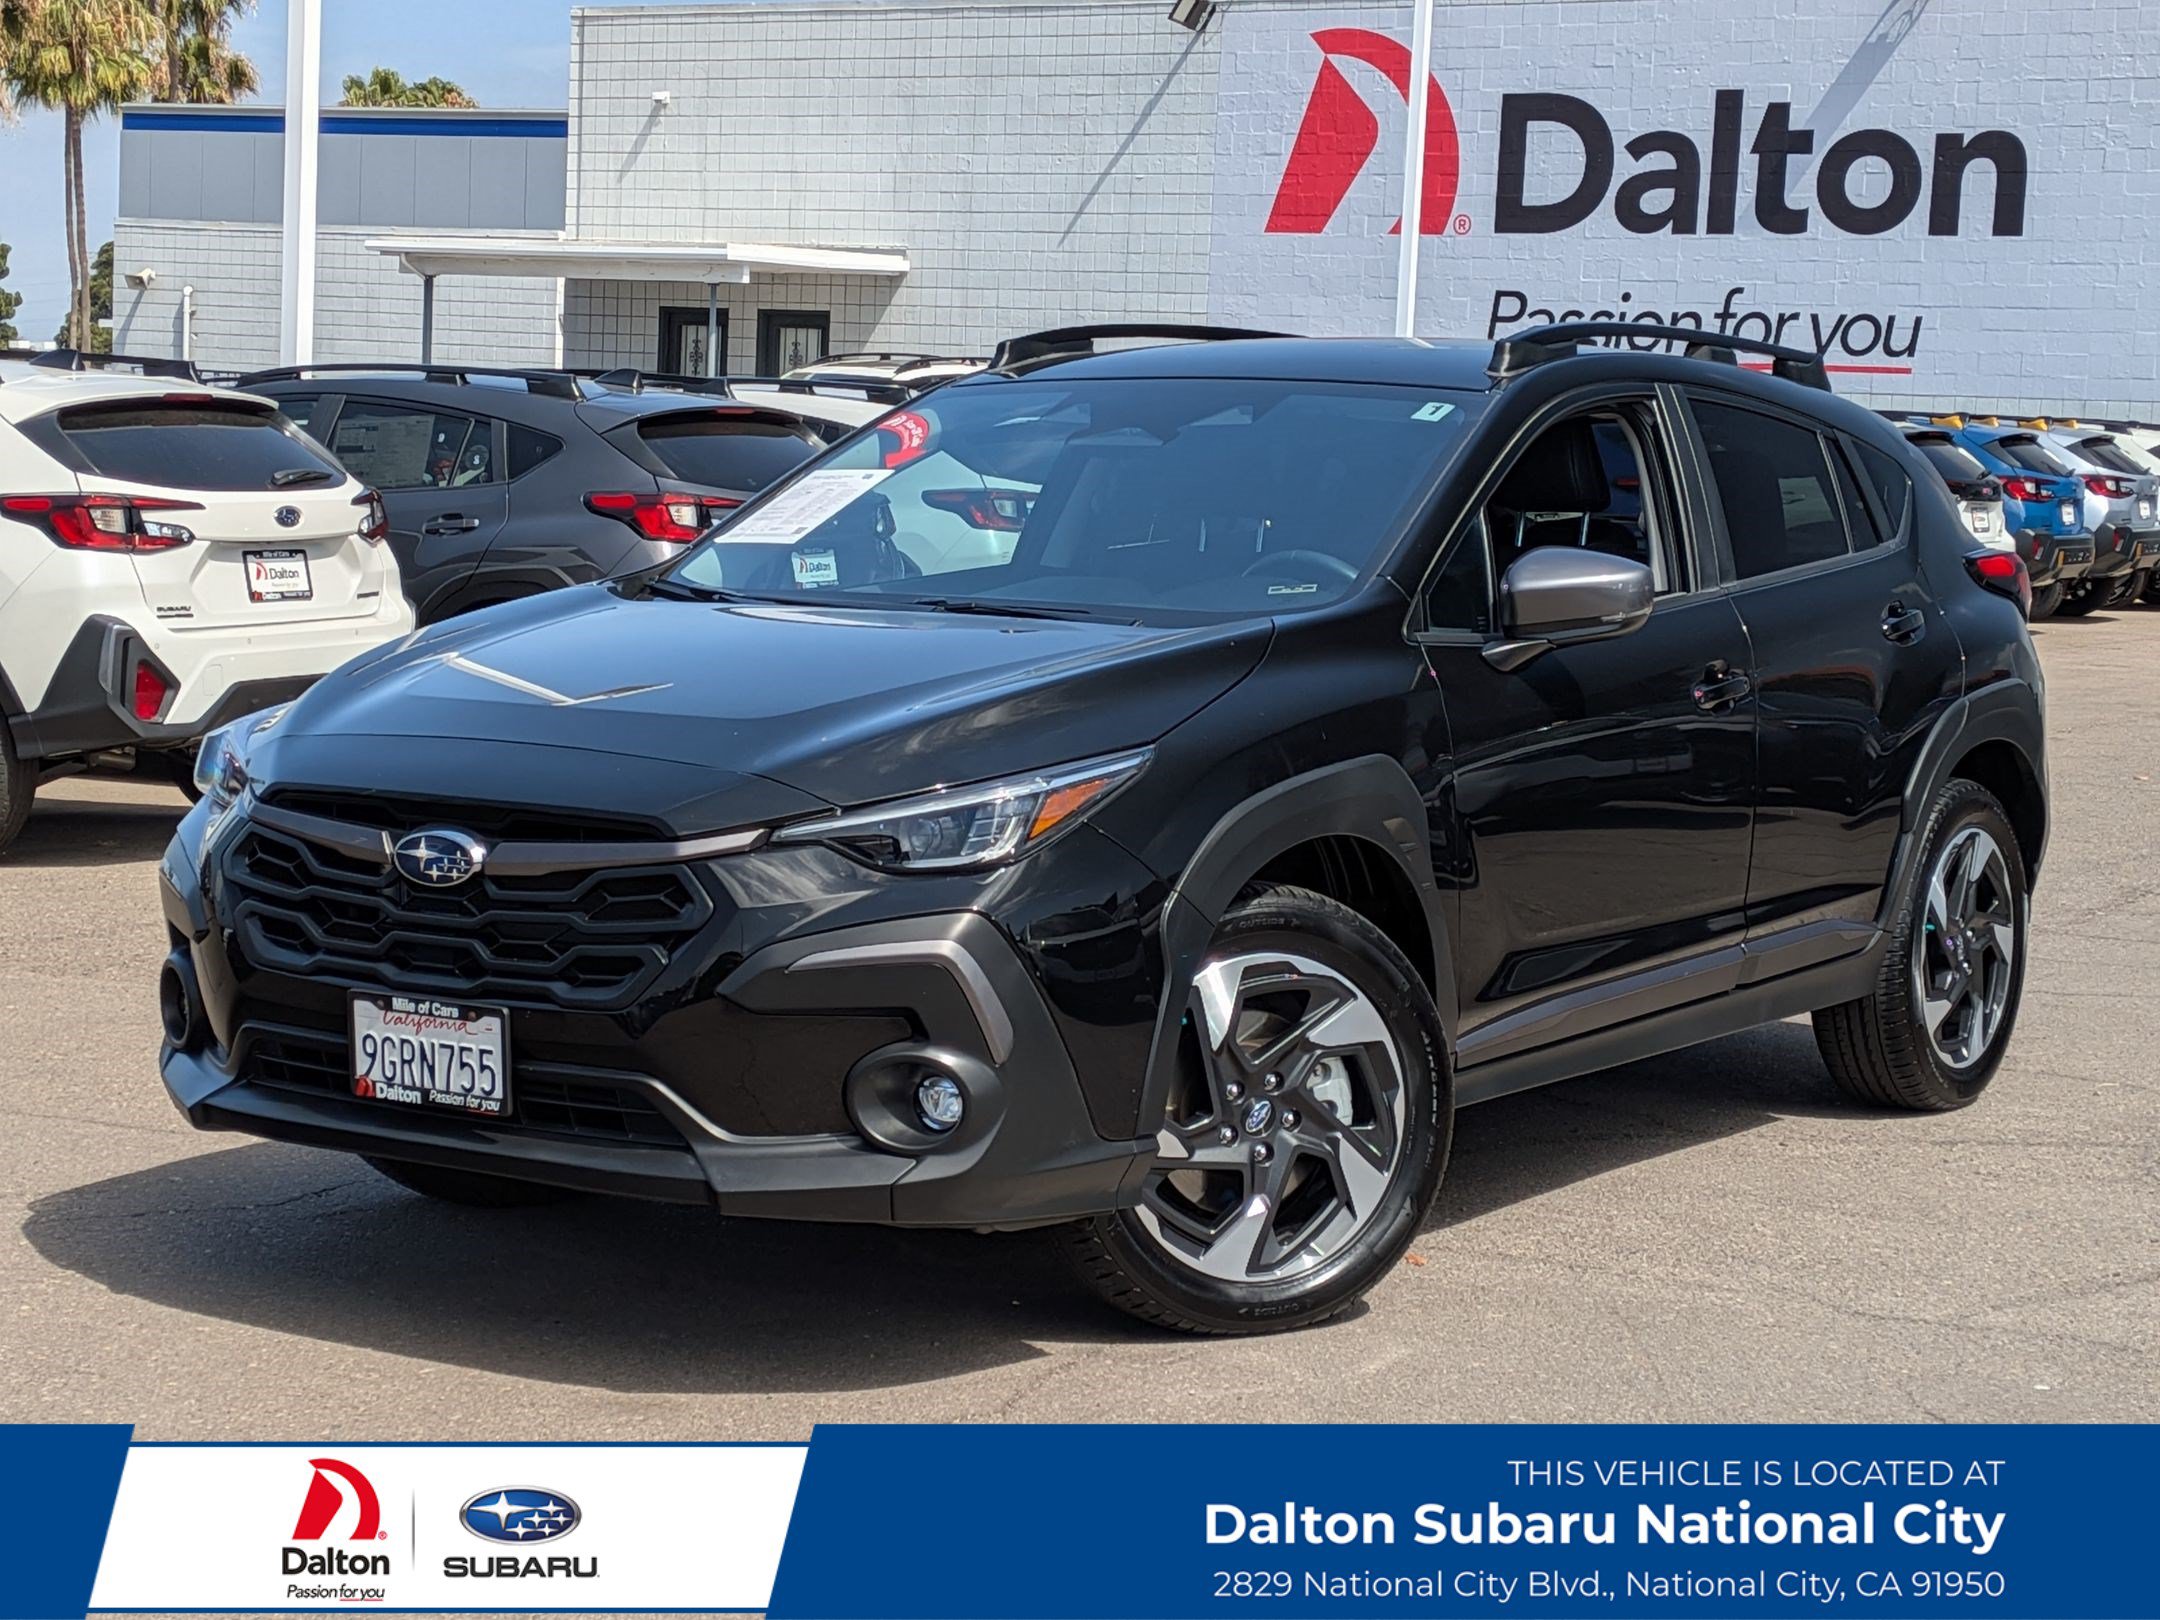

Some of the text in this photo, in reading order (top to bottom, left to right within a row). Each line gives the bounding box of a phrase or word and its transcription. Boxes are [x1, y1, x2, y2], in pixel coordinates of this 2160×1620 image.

[1495, 89, 2027, 237] Dalton
[1714, 287, 1800, 353] for
[1809, 313, 1923, 358] you
[269, 567, 299, 580] Dalton
[391, 996, 460, 1019] Mile of Cars
[382, 1010, 479, 1036] California
[361, 1032, 497, 1097] 9GRN755
[375, 1082, 422, 1105] Dalton
[429, 1089, 501, 1112] Passion for you
